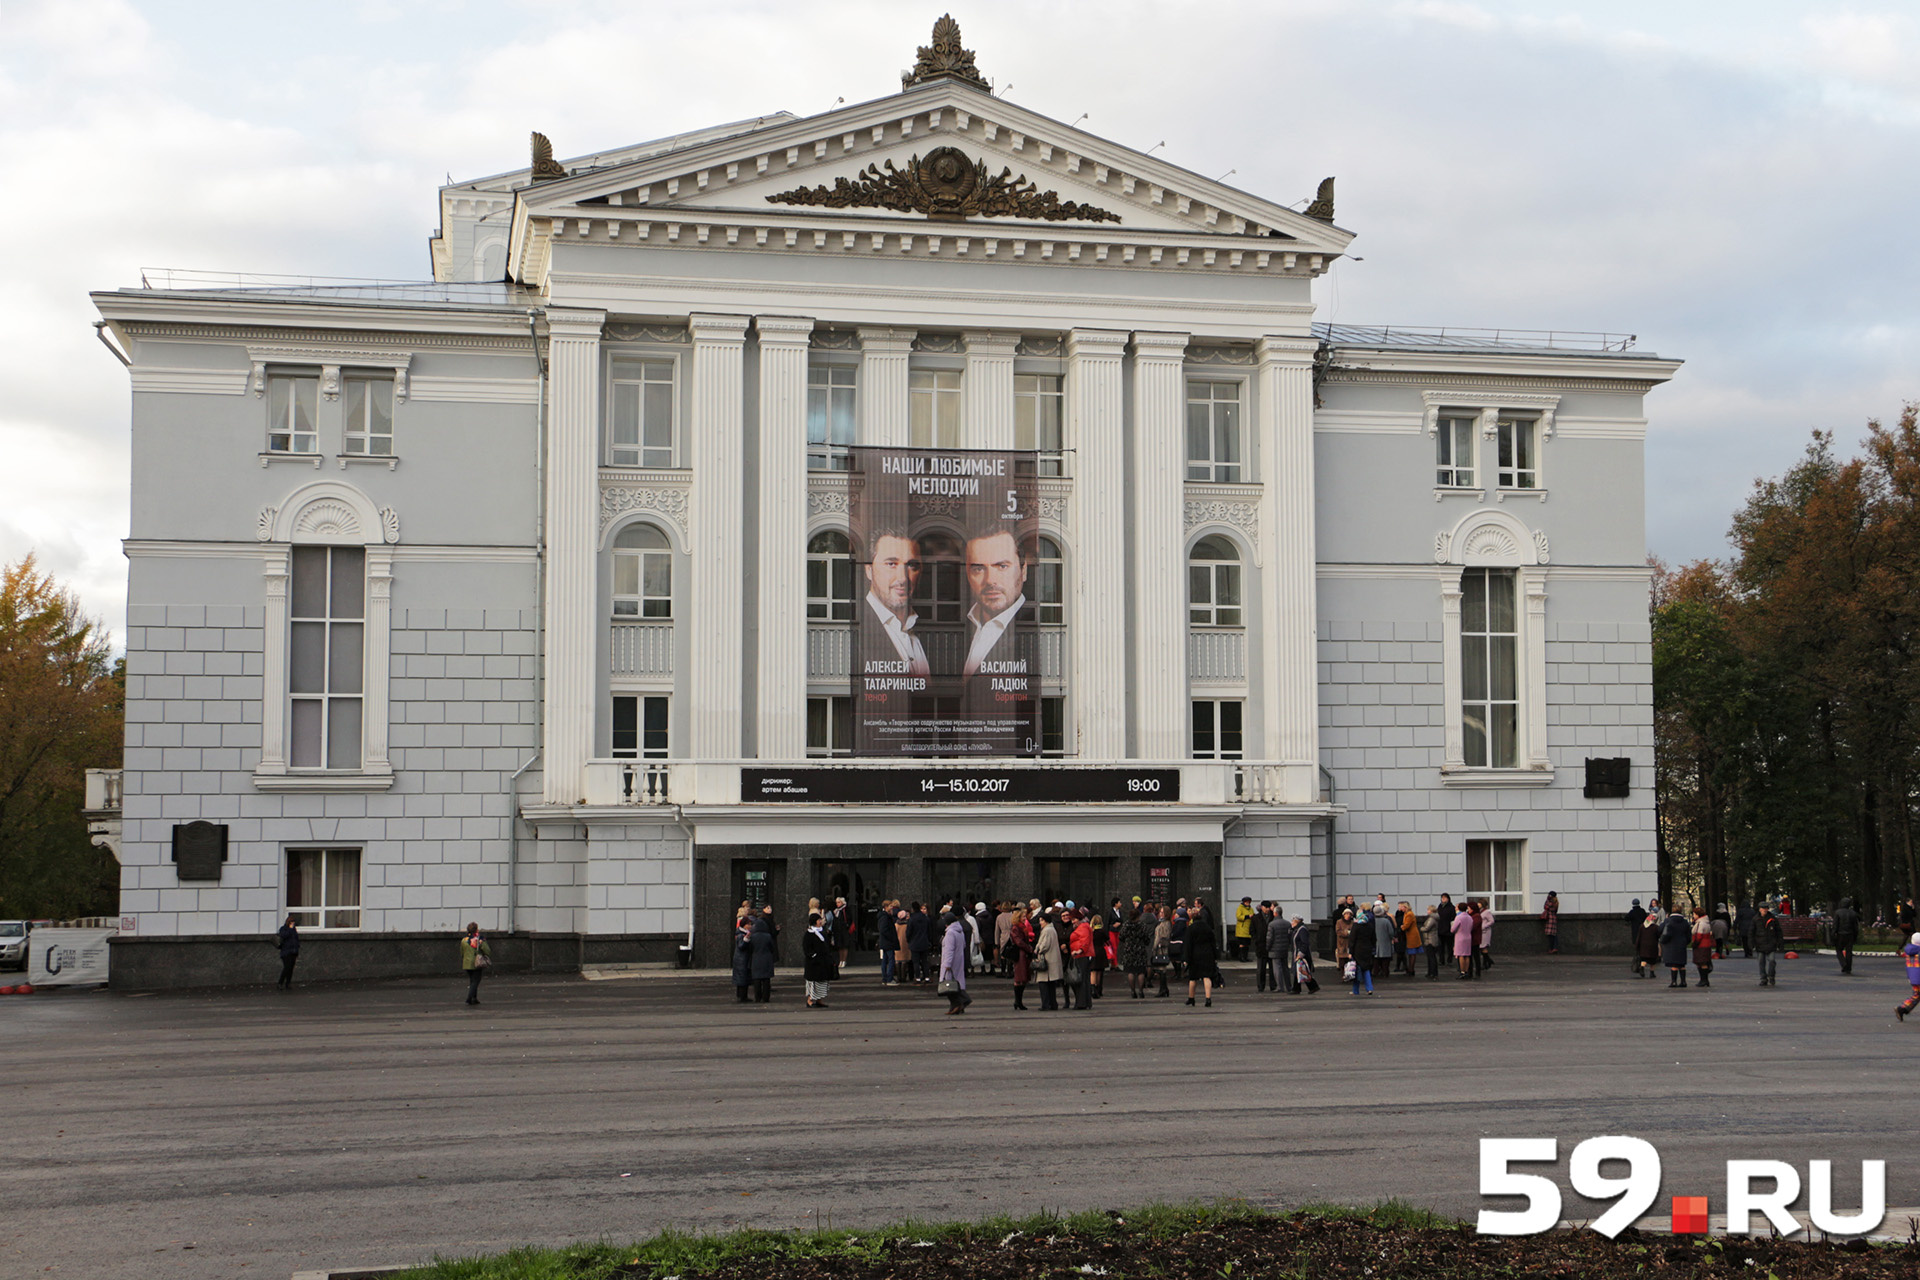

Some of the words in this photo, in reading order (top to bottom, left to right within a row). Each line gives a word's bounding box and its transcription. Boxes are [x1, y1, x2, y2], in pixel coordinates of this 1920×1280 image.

[882, 456, 925, 475] НАШИ
[929, 457, 1005, 477] ЛЮБИМЫЕ
[908, 477, 979, 498] МЕЛОДИИ
[1006, 490, 1017, 513] 5
[864, 659, 910, 674] АЛЕКСЕЙ
[980, 659, 1027, 674] ВАСИЛИЙ
[864, 678, 926, 693] ТАТАРИНЦЕВ
[991, 678, 1028, 692] ЛАДЮК
[864, 693, 888, 704] тенор
[995, 691, 1028, 704] баритон
[1025, 737, 1039, 753] 0+
[761, 786, 782, 794] артем
[1126, 779, 1161, 792] 19:00
